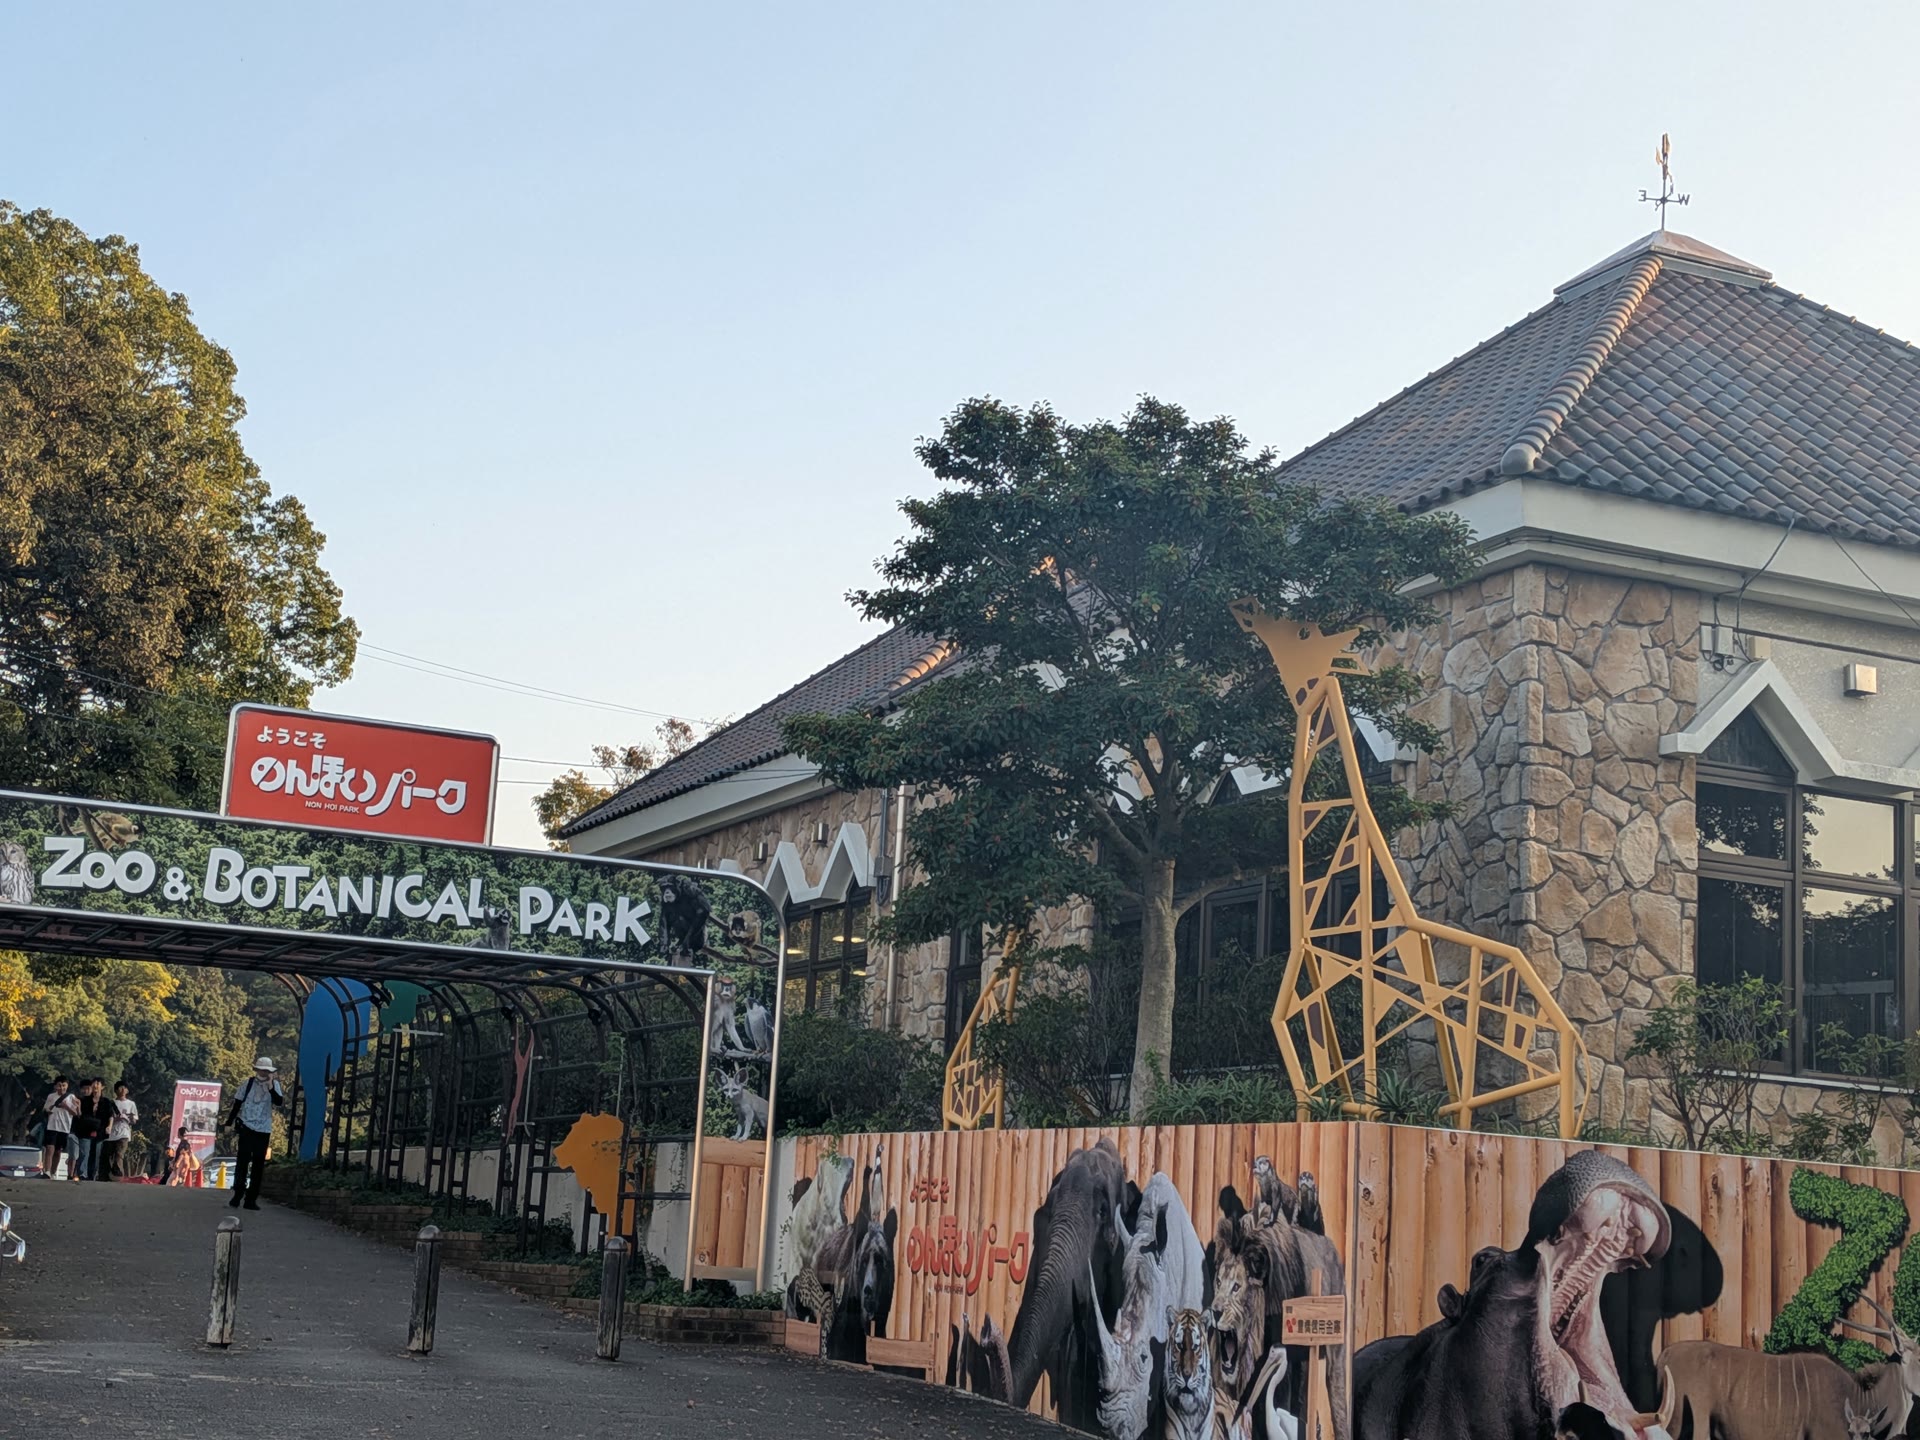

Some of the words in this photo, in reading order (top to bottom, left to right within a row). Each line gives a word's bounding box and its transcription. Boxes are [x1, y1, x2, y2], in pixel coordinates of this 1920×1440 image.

[257, 725, 327, 749] ようこそ
[250, 754, 467, 816] のんほいパーク
[304, 800, 323, 809] NON
[324, 803, 338, 811] HOI
[339, 804, 360, 814] PARK
[163, 867, 192, 901] &
[519, 886, 651, 946] PARK
